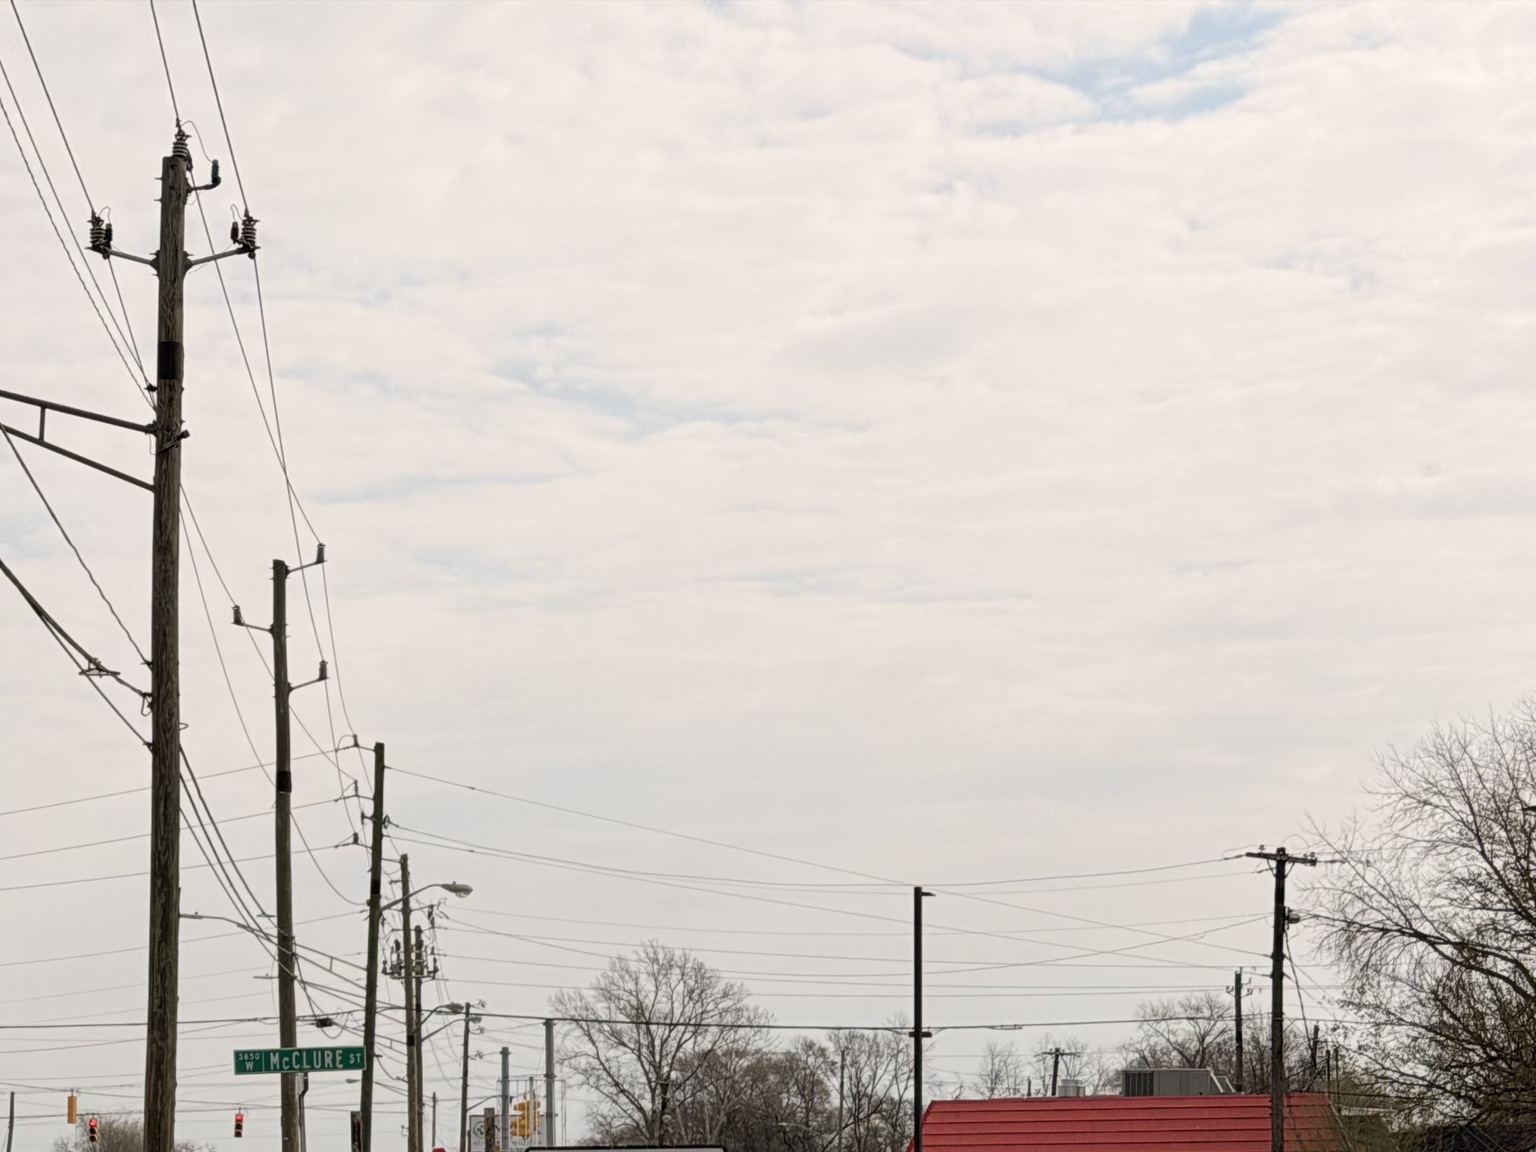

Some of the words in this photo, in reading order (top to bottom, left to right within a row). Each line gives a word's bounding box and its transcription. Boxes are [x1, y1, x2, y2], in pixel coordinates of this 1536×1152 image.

[245, 1061, 254, 1071] W
[270, 1050, 343, 1070] McCLURE
[349, 1053, 362, 1064] ST
